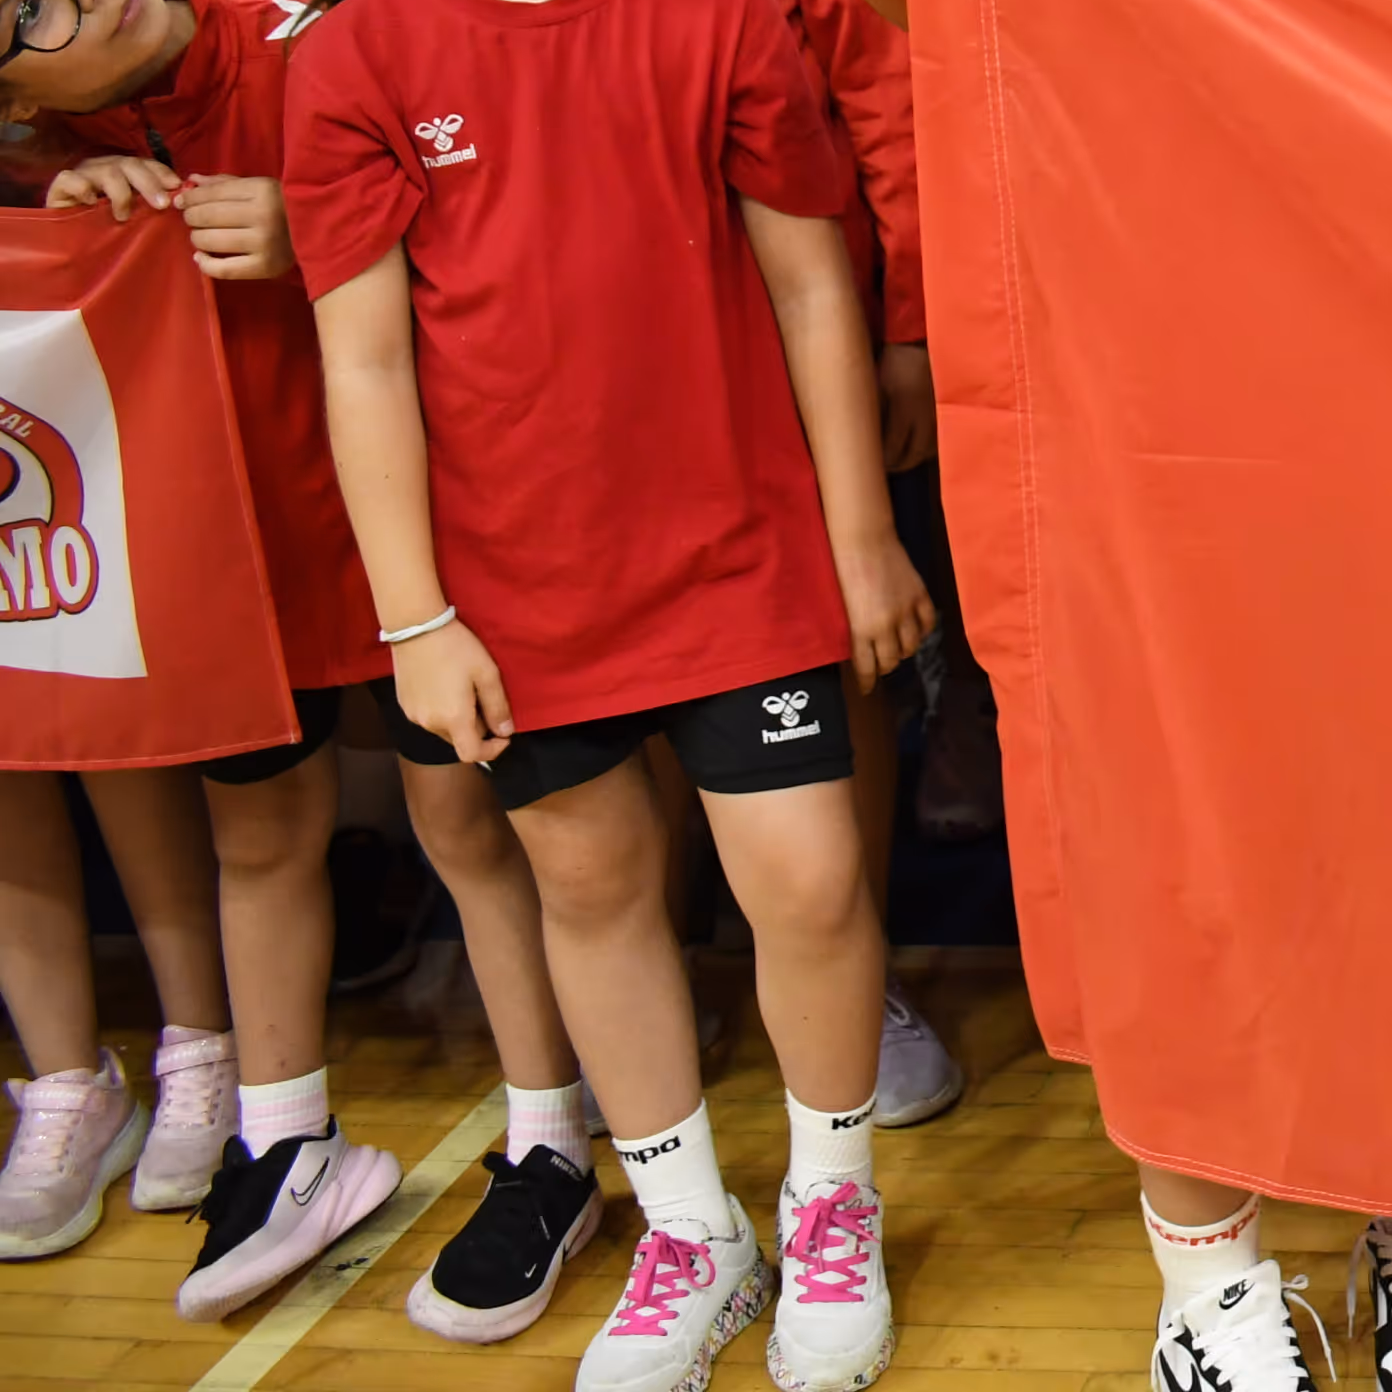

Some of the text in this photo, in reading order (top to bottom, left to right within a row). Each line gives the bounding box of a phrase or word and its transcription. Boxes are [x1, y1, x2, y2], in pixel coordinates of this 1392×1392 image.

[421, 142, 477, 170] hummel
[761, 719, 822, 745] hummel
[1222, 1279, 1247, 1302] NIKE
